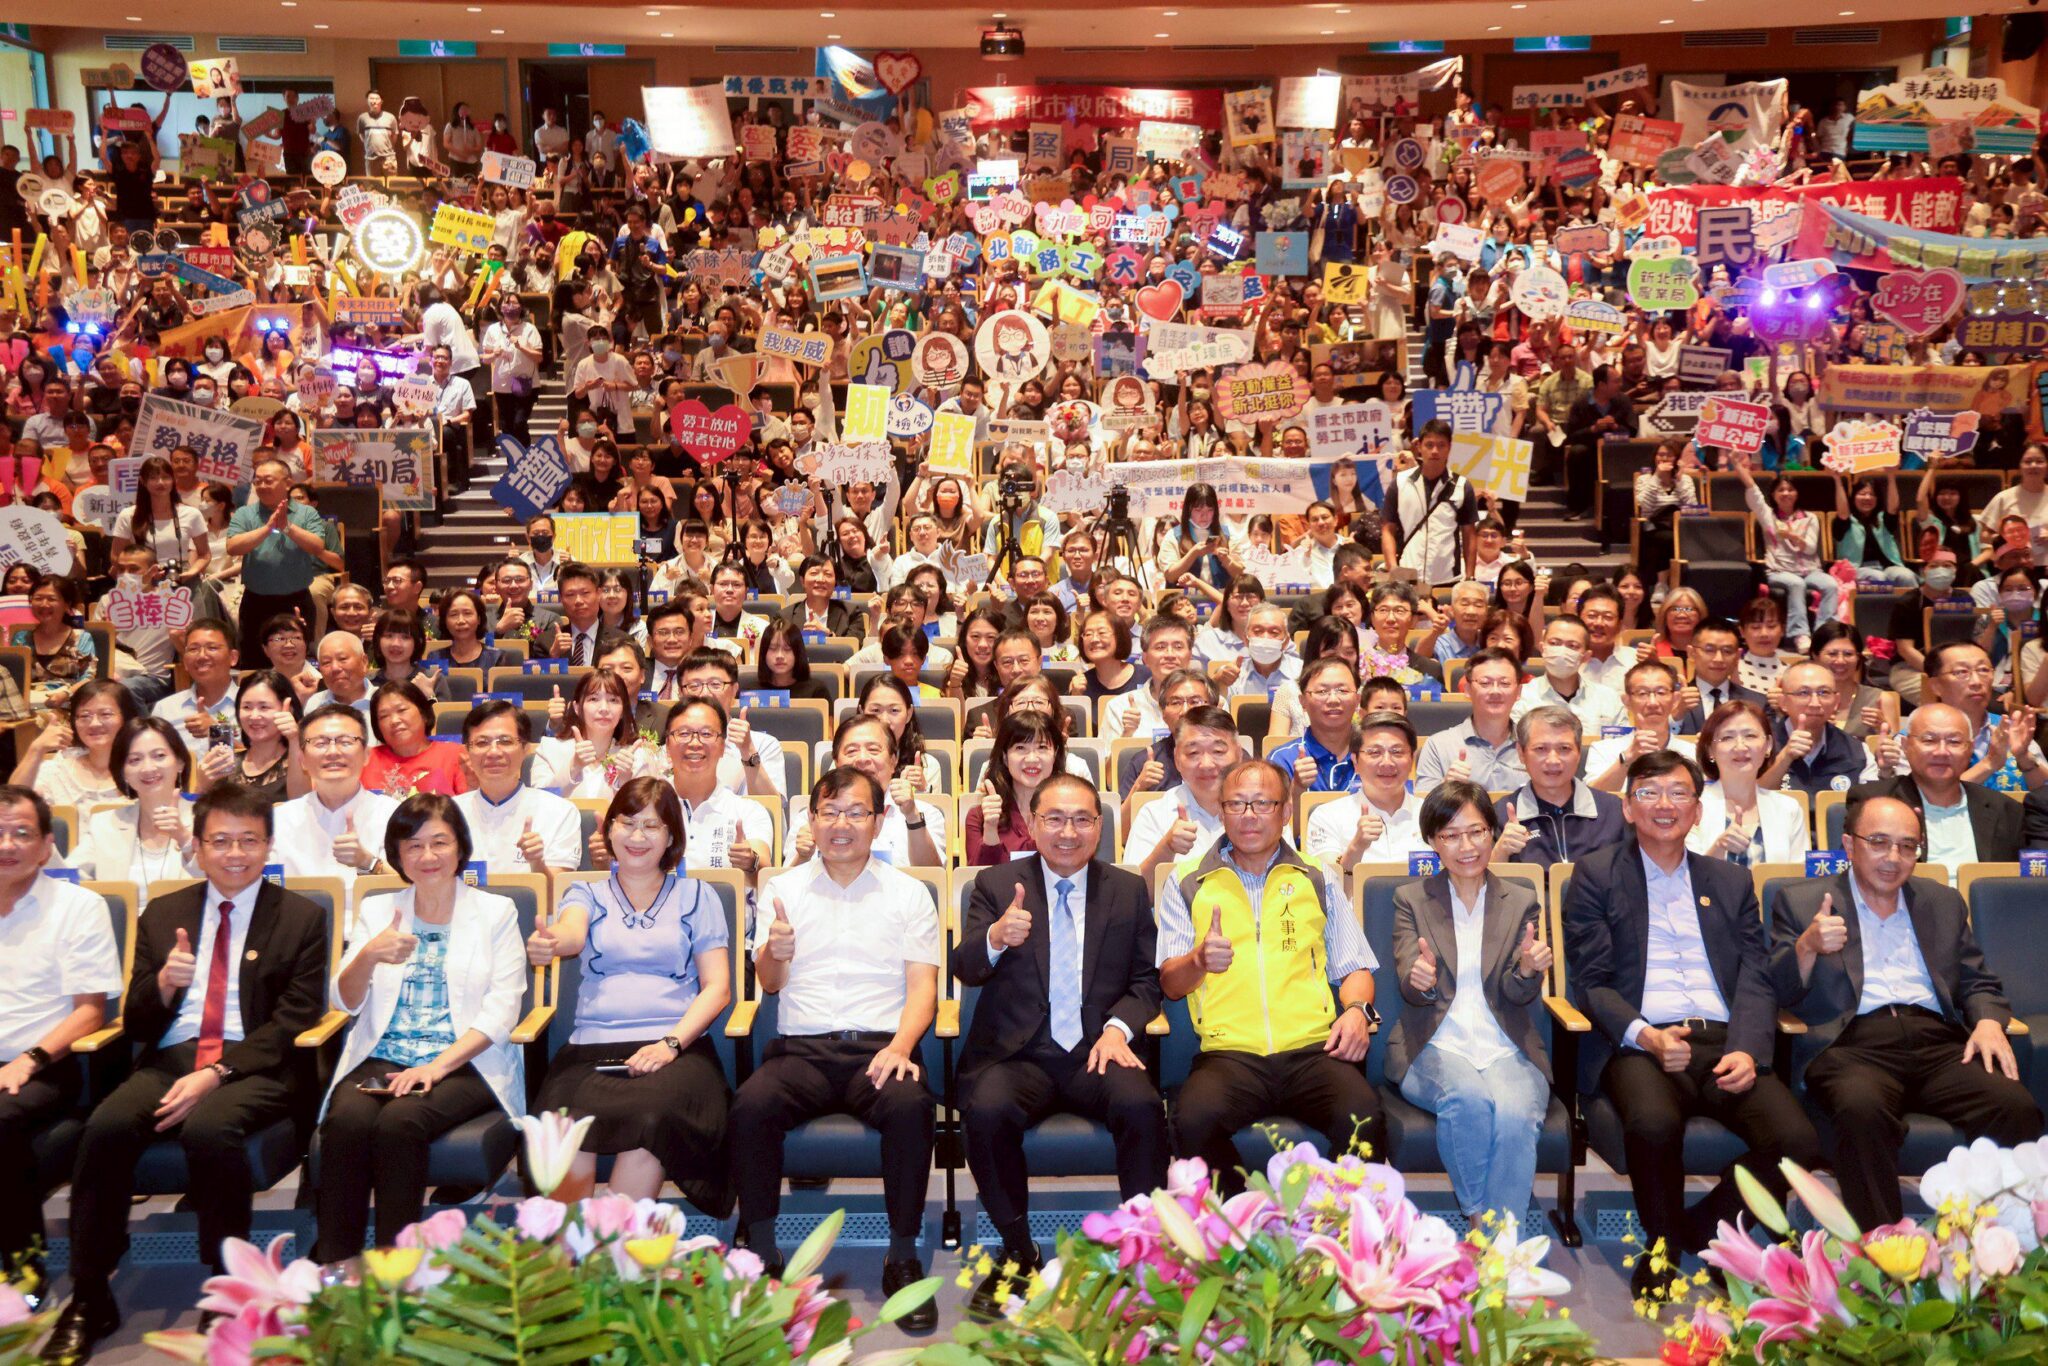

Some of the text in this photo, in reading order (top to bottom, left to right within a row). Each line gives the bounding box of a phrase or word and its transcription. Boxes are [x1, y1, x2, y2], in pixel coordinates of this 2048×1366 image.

[989, 239, 1009, 261] 北
[1115, 256, 1137, 279] 大
[764, 331, 828, 362] 我好威
[1231, 374, 1293, 398] 勞動權益
[1232, 392, 1296, 415] 新北挺你
[682, 414, 739, 433] 勞工放心
[1314, 408, 1383, 428] 新北市政府
[681, 431, 736, 449] 業者安心
[134, 593, 164, 628] 棒
[1280, 903, 1298, 952] 人事處
